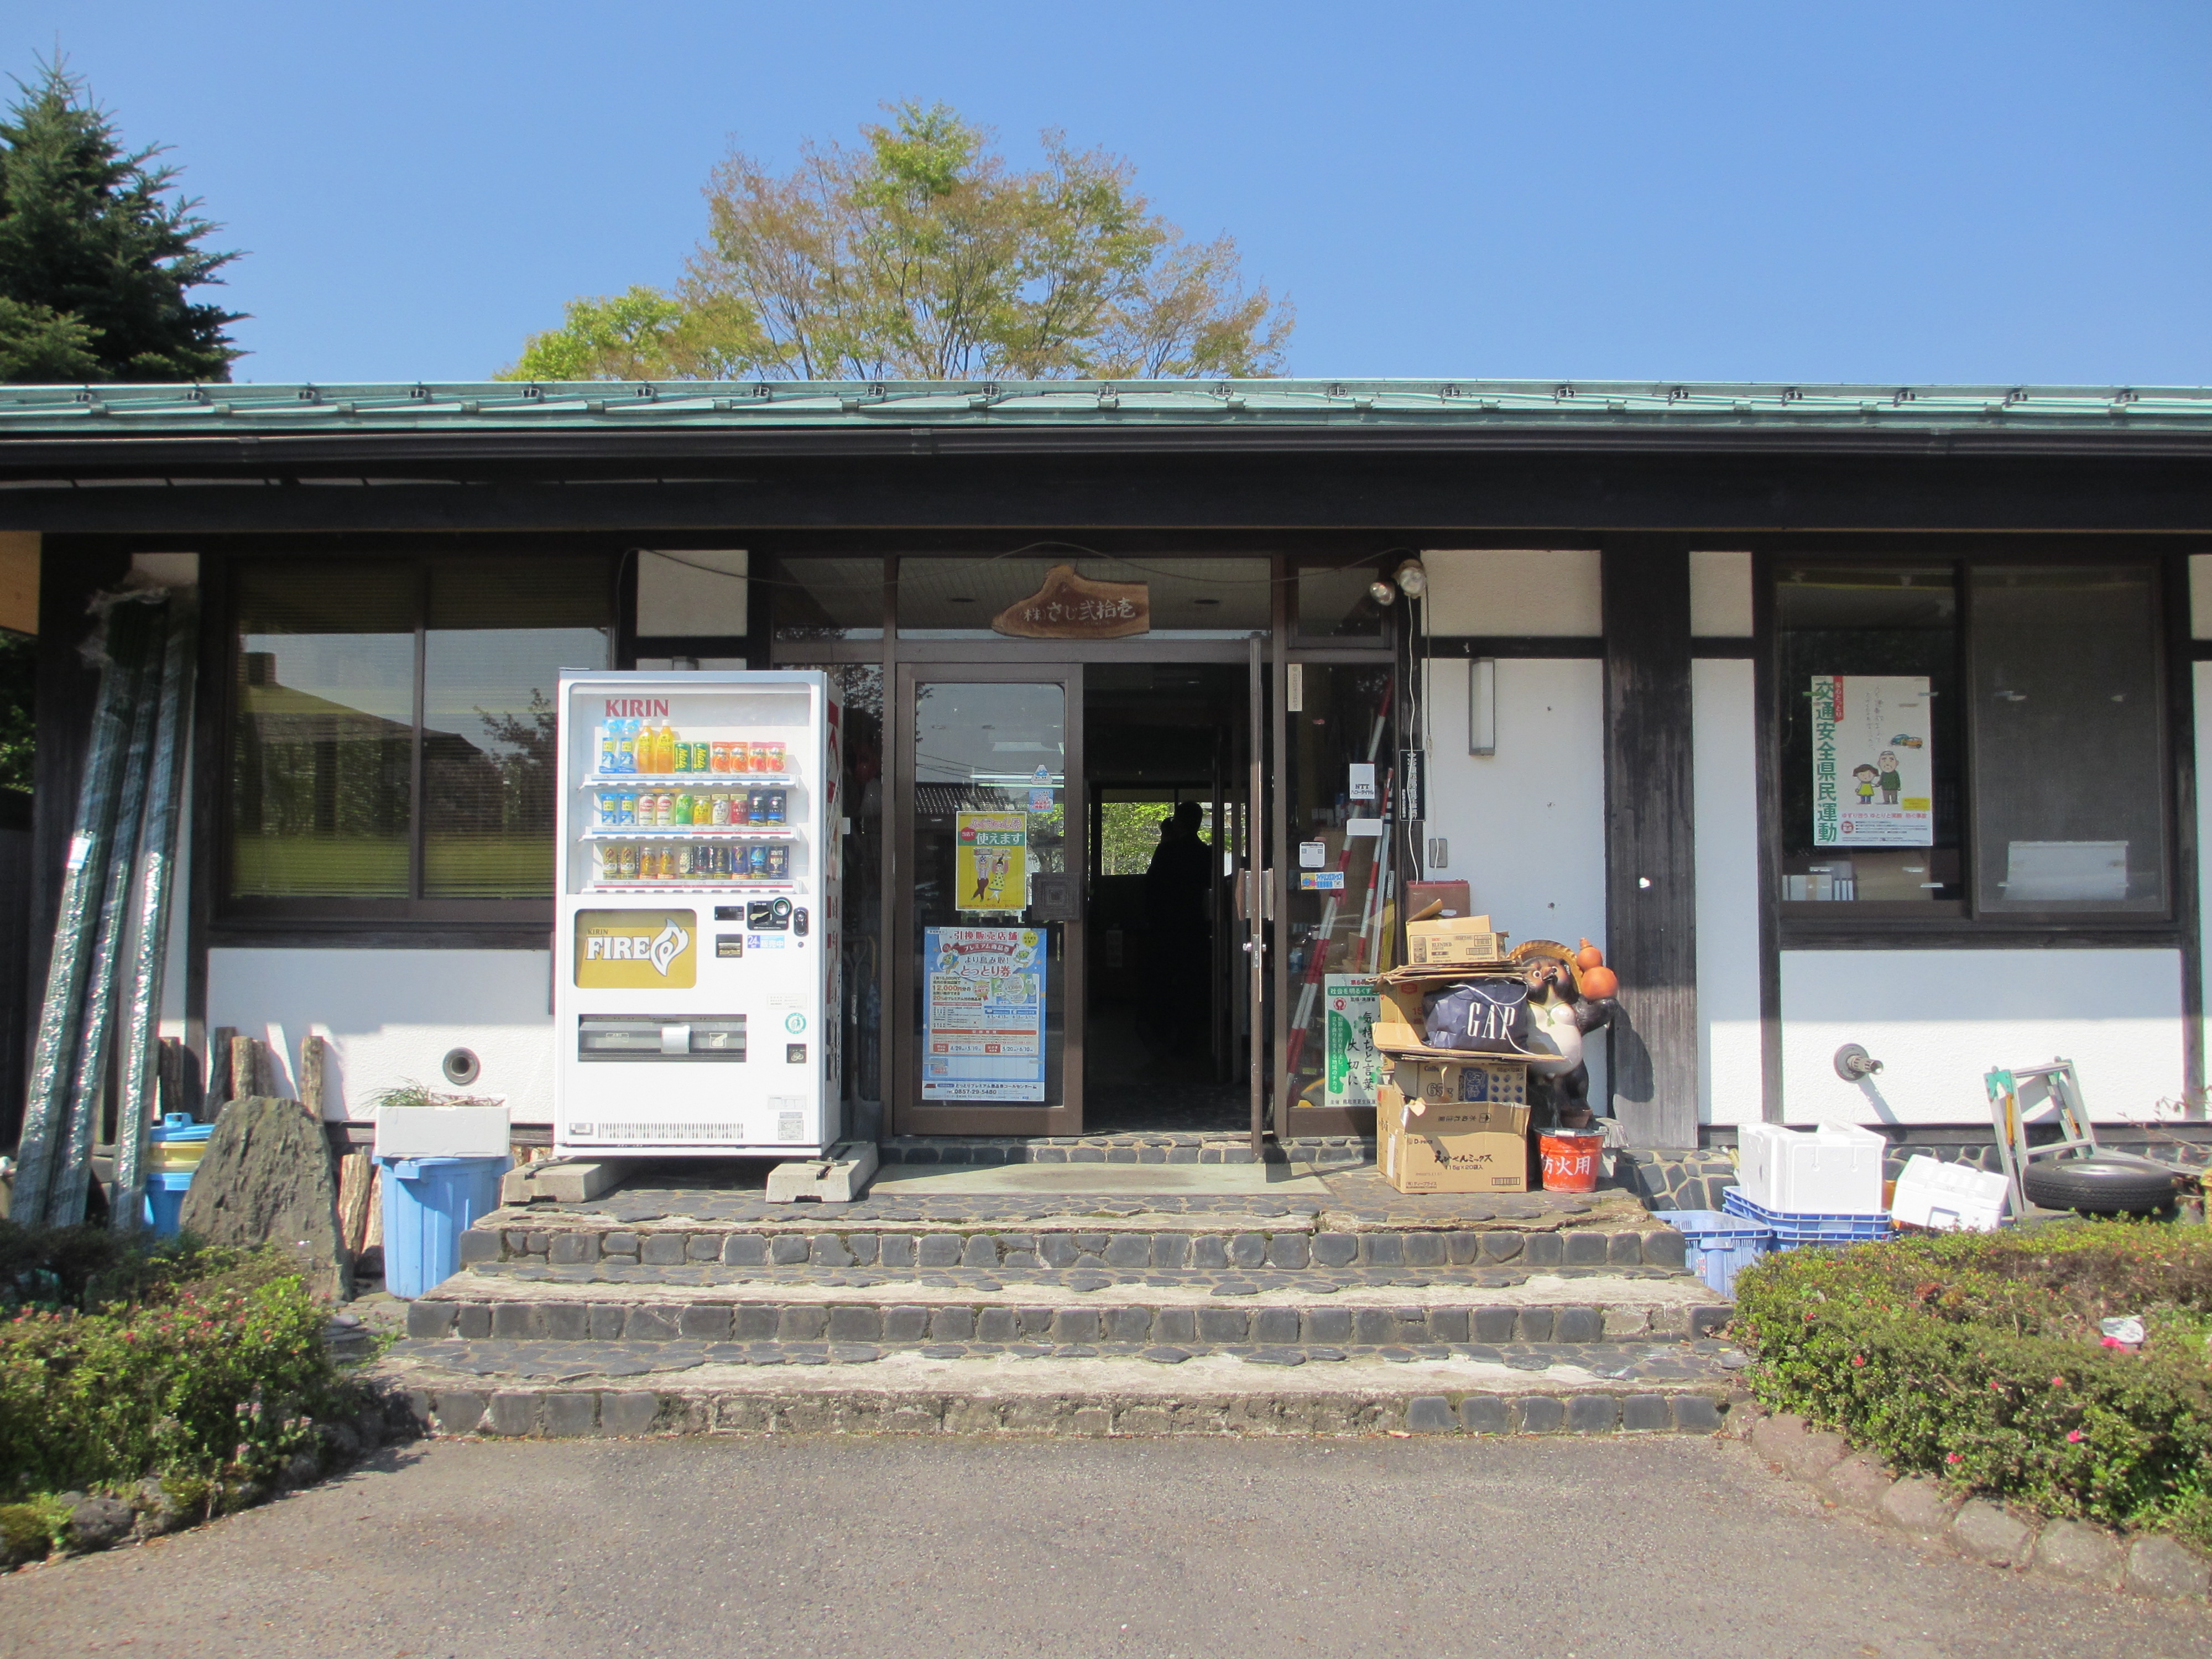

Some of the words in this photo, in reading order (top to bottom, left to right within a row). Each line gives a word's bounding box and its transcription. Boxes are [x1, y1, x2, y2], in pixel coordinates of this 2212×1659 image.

[605, 699, 669, 717] KIRIN
[1815, 680, 1837, 842] 交通安全県民運動
[975, 832, 1022, 845] 使えます
[953, 931, 1018, 941] 引換販売店舗
[586, 936, 650, 960] FIRE
[963, 943, 1010, 953] プレミアム商品券
[959, 966, 1011, 977] とっとり券
[1467, 1001, 1516, 1040] GAP
[1363, 1011, 1375, 1091] 気持ちと言葉
[1347, 1038, 1360, 1086] 大切に
[1434, 1150, 1493, 1163] えびせんミックス
